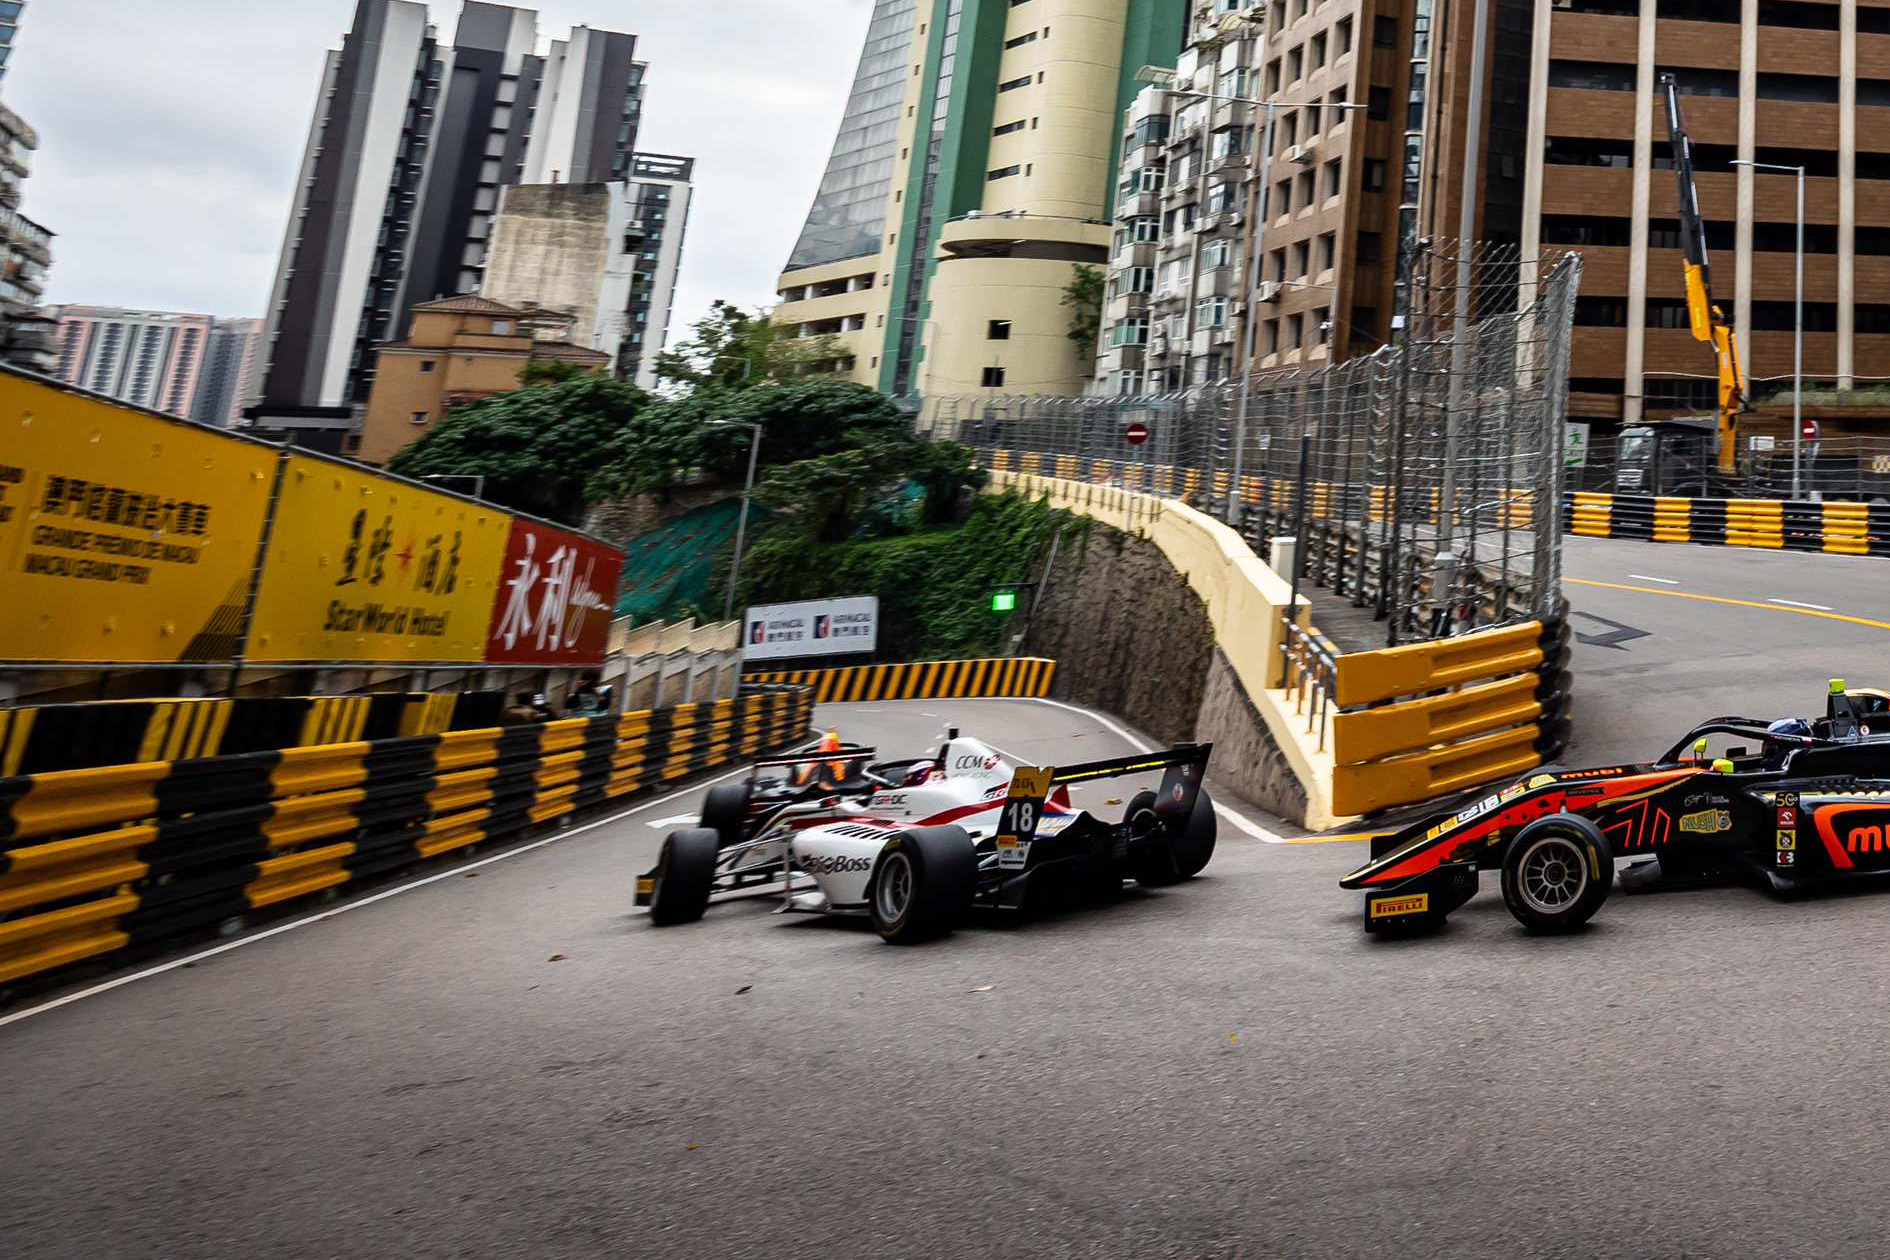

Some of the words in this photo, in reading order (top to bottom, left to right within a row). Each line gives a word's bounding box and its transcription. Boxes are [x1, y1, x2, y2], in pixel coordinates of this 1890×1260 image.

[493, 532, 578, 651] 永利
[406, 606, 451, 638] Hotel
[954, 754, 984, 770] CCM
[1561, 766, 1623, 779] mubi
[1007, 802, 1034, 833] 18
[1375, 897, 1424, 914] PIRELLI
